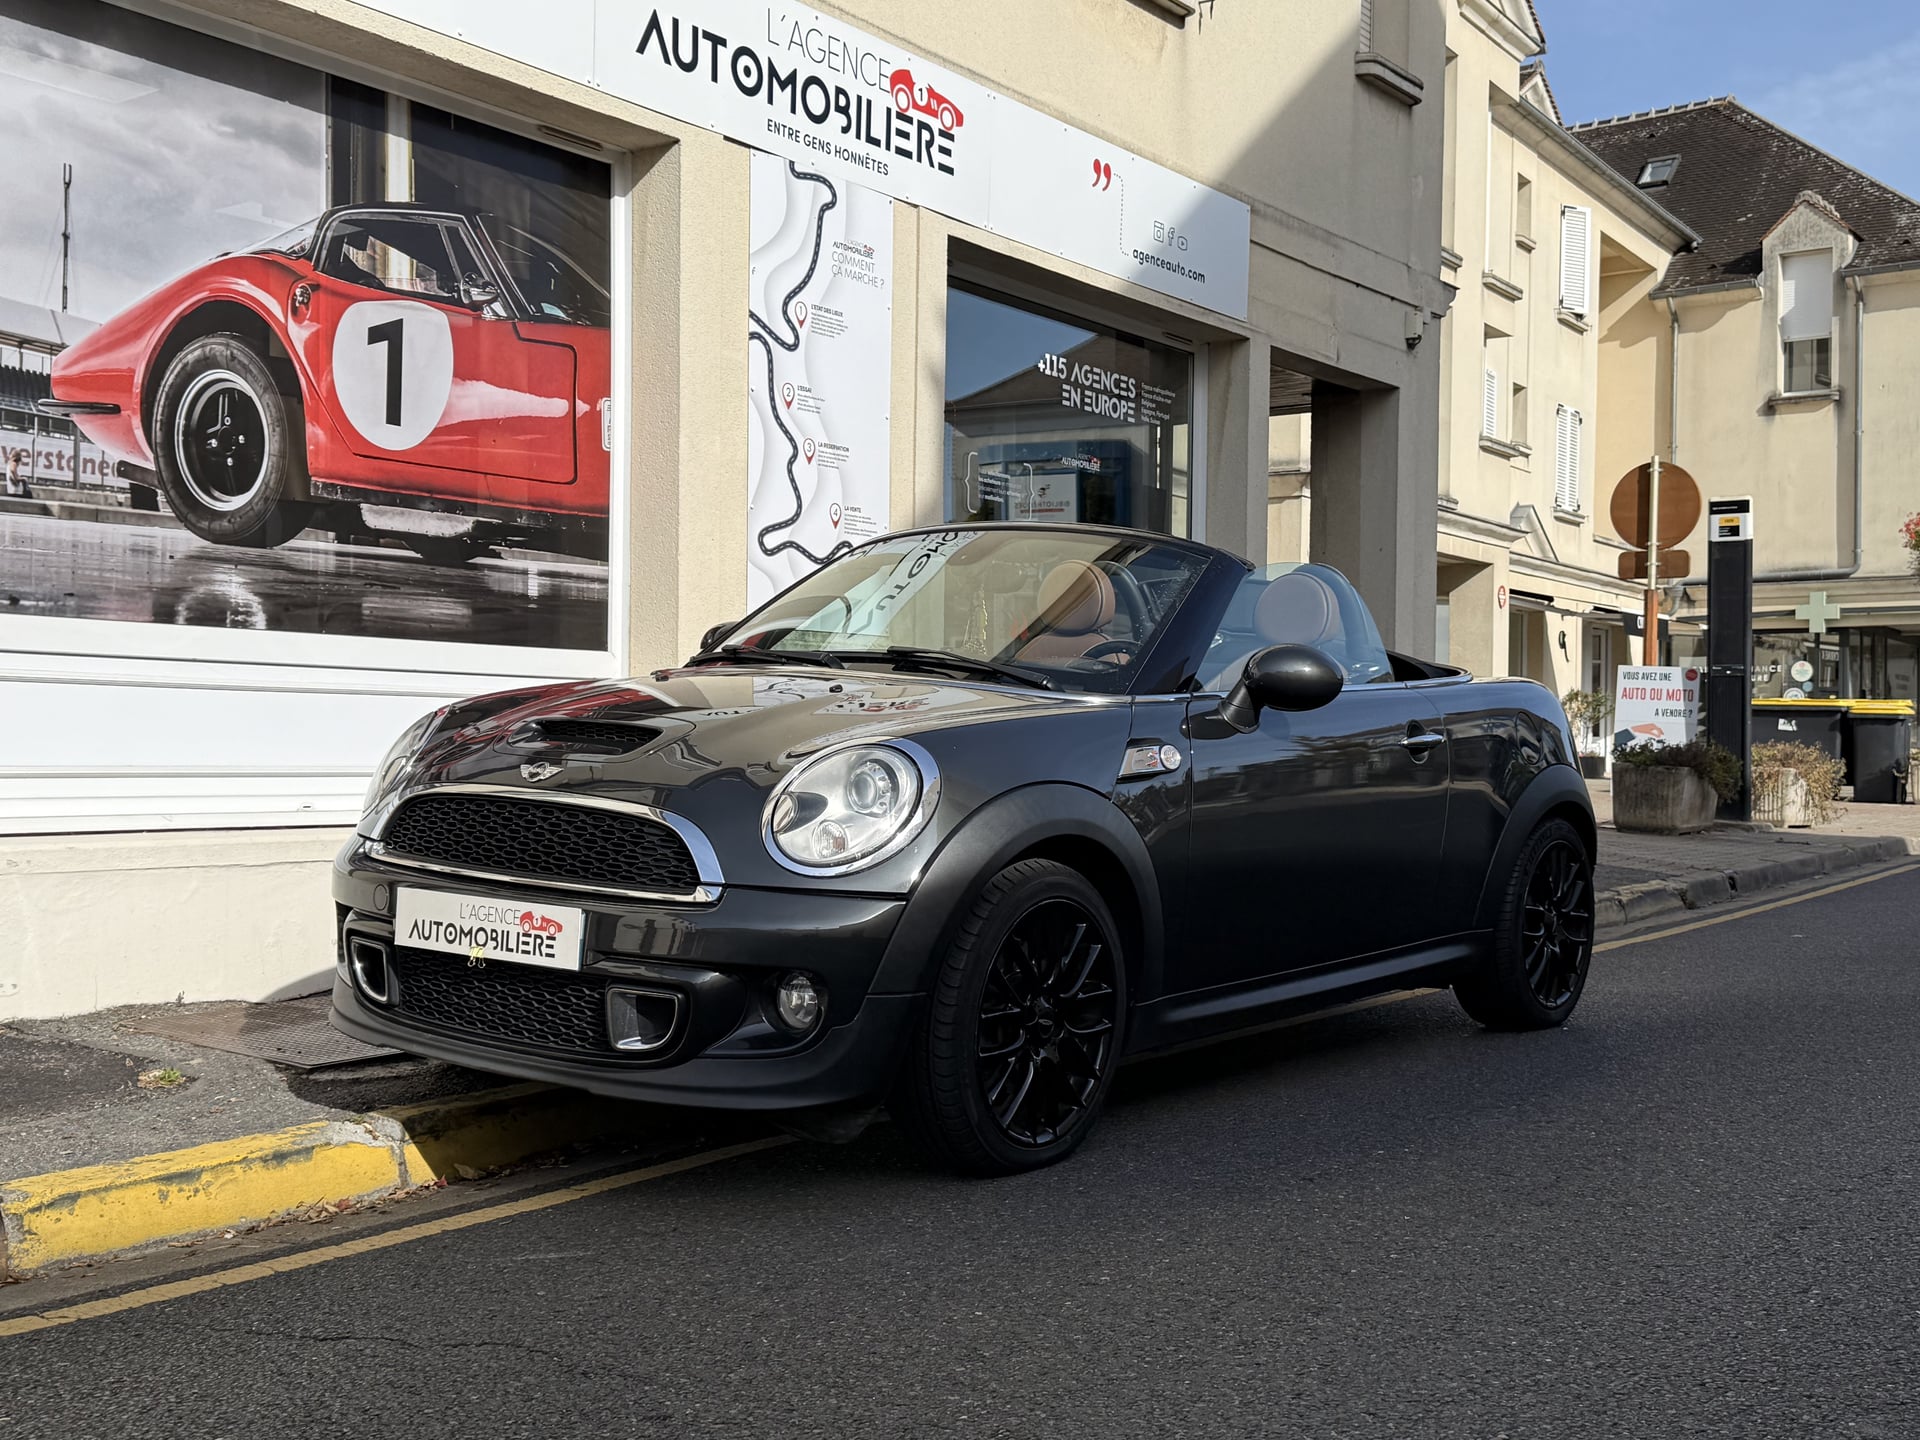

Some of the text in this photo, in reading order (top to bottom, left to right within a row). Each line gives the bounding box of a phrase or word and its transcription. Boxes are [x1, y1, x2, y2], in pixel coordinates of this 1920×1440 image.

[768, 8, 891, 94] L'AGENCE
[767, 118, 889, 176] ENTRE GENS HONNÊTES
[832, 250, 875, 273] COMMENT
[1132, 248, 1206, 284] agenceauto.com
[831, 264, 842, 278] ÇA
[844, 267, 878, 288] MARCHE
[367, 318, 403, 427] 1
[1038, 353, 1136, 399] +115 AGENCES
[786, 387, 792, 398] 2
[1062, 383, 1135, 423] EN EUROPE
[806, 442, 812, 453] 3
[833, 508, 838, 517] 4
[1622, 671, 1673, 682] VOUS AVEZ UNE
[1621, 687, 1695, 702] AUTO OU MOTO
[460, 902, 521, 926] L'AGENCE
